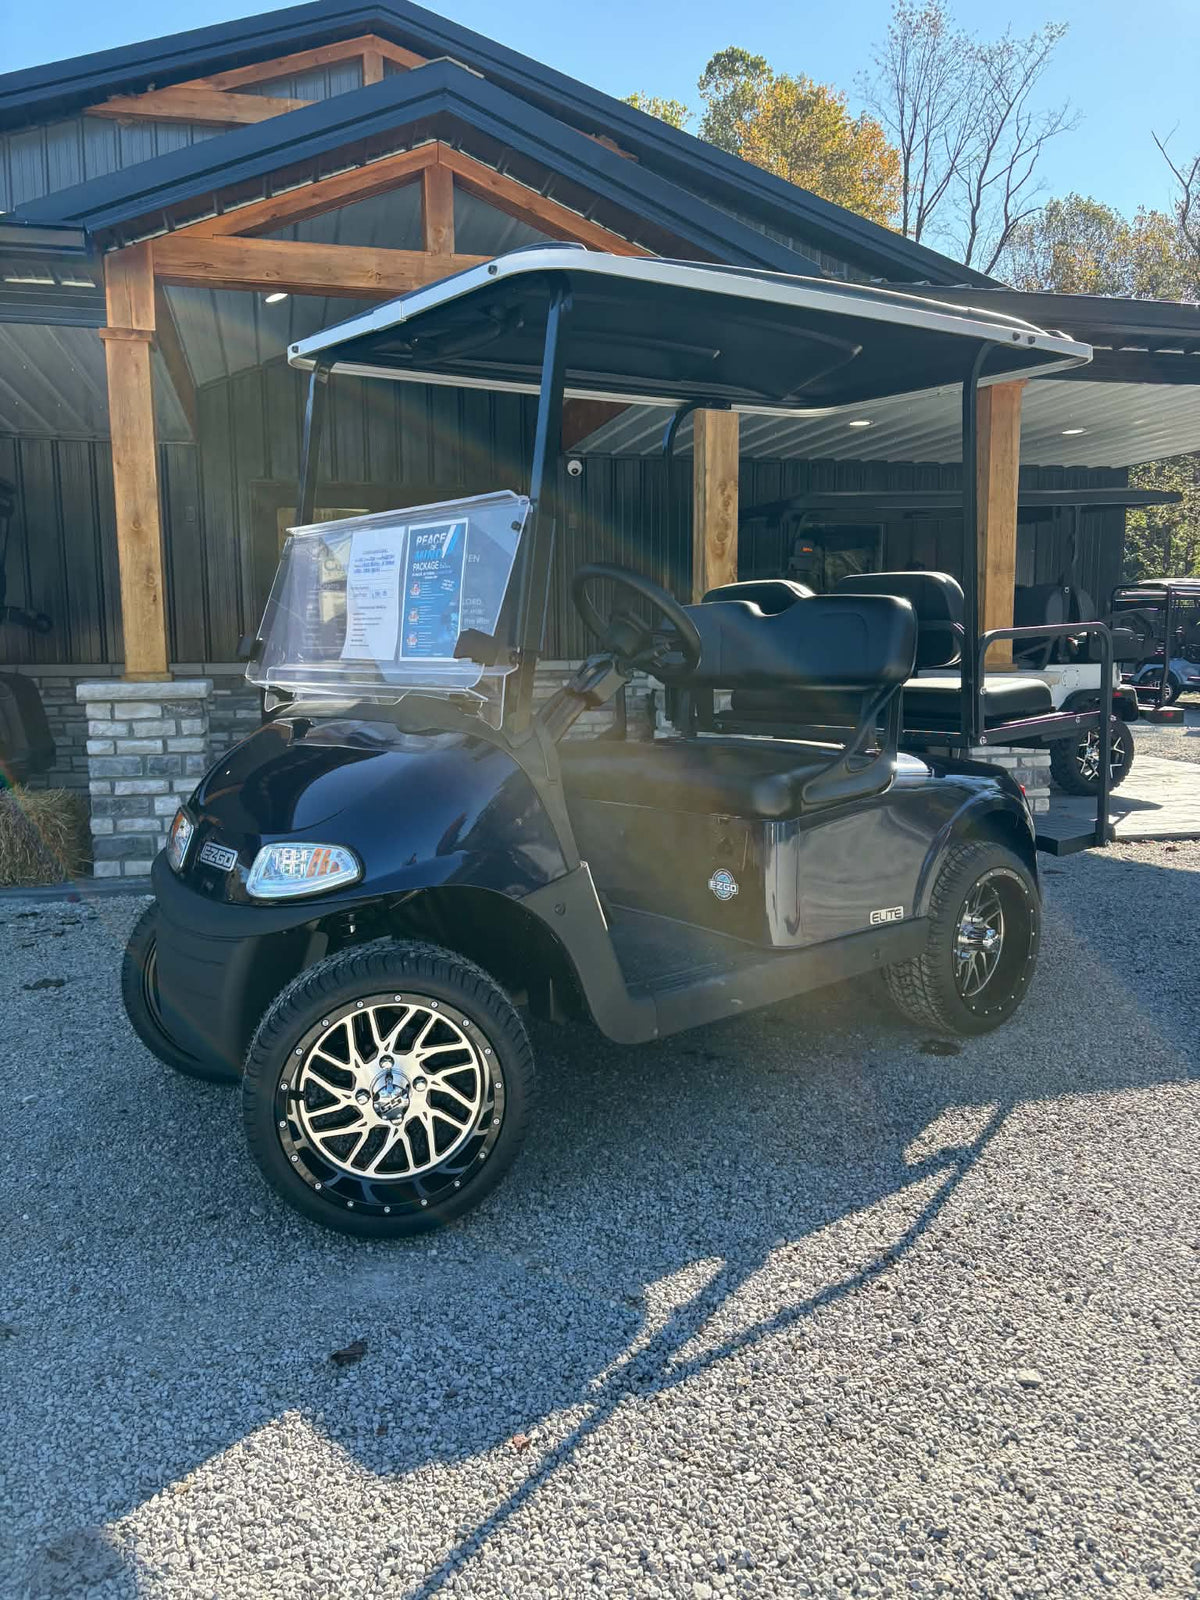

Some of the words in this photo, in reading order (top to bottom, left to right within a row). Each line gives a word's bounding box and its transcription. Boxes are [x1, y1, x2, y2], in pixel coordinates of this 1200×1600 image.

[415, 532, 447, 546] PEACE
[412, 560, 440, 571] PACKAGE
[202, 844, 235, 868] EZGO
[709, 879, 738, 893] EZGO
[872, 908, 902, 923] ELITE
